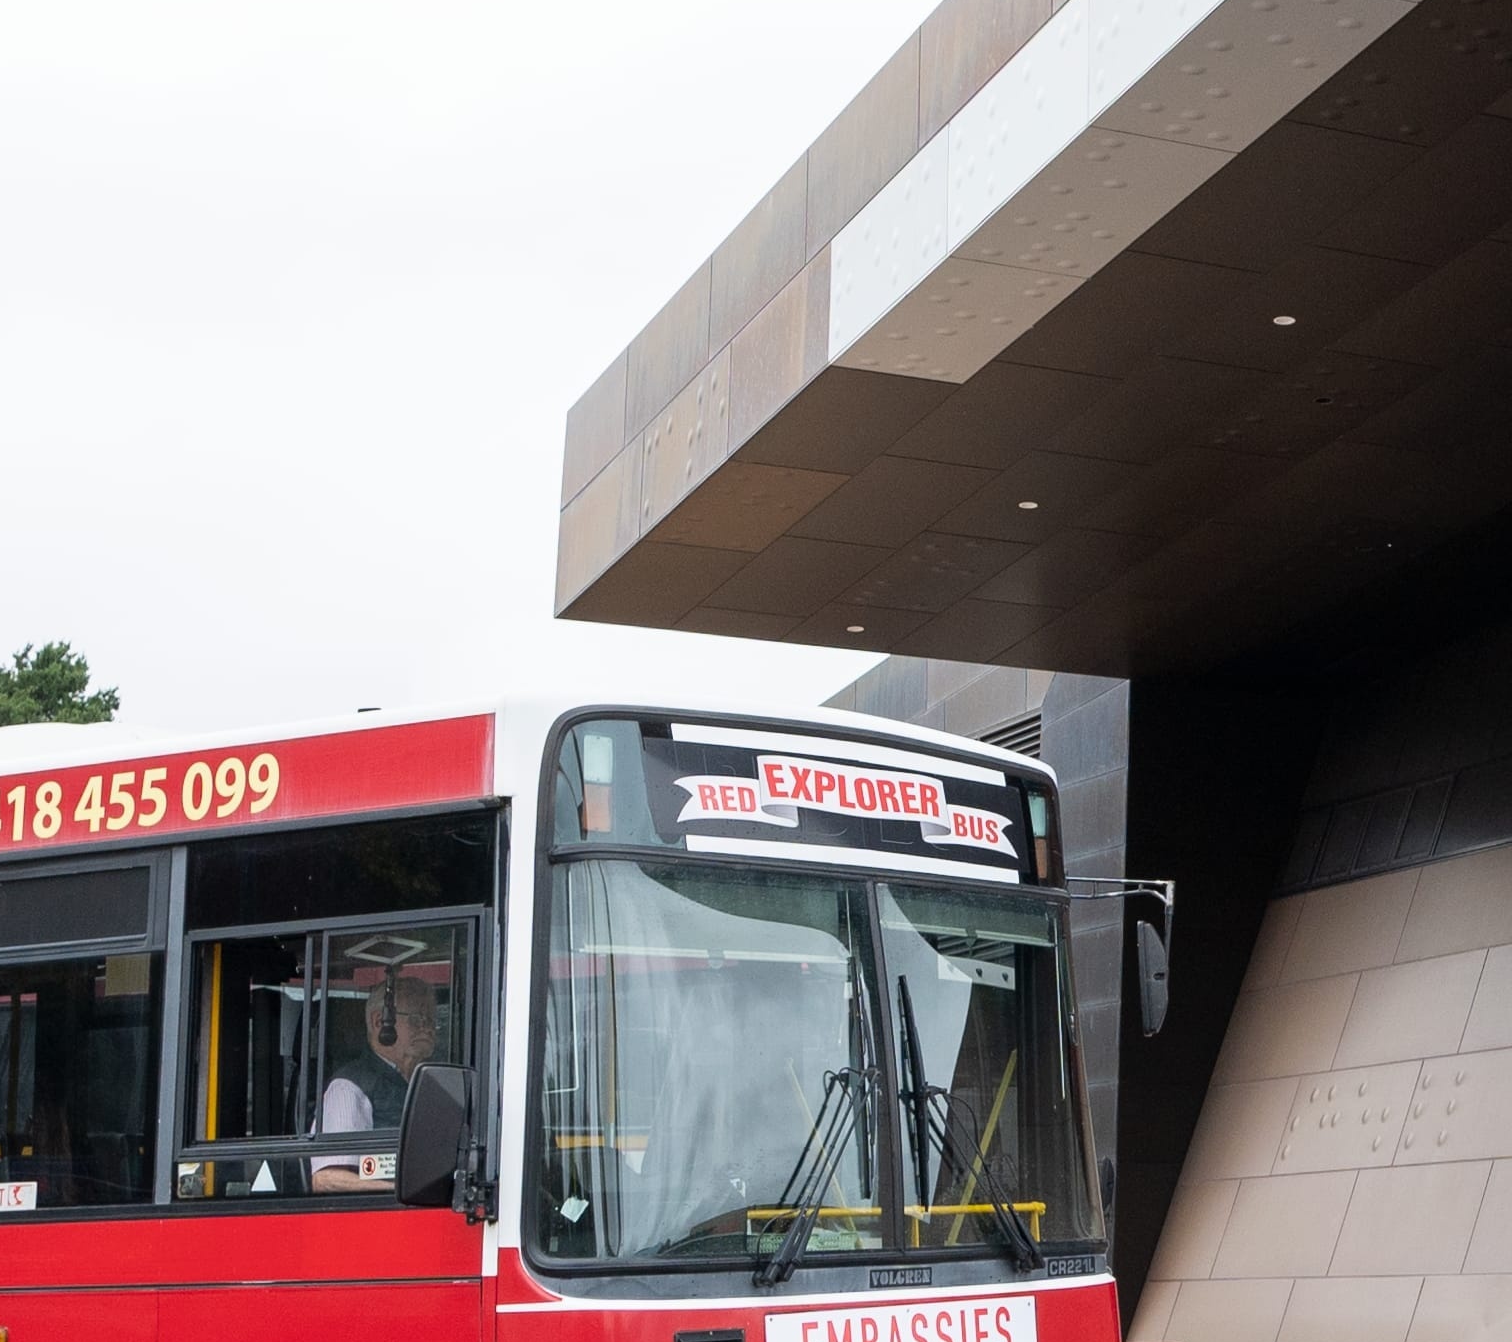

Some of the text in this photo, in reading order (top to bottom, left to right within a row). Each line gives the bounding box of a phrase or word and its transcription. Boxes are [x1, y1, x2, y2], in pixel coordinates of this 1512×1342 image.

[74, 767, 167, 832] 455
[182, 753, 280, 821] 099
[697, 763, 999, 844] RED EXPLORER BUS
[871, 1258, 1094, 1286] VOLGREN CR221L
